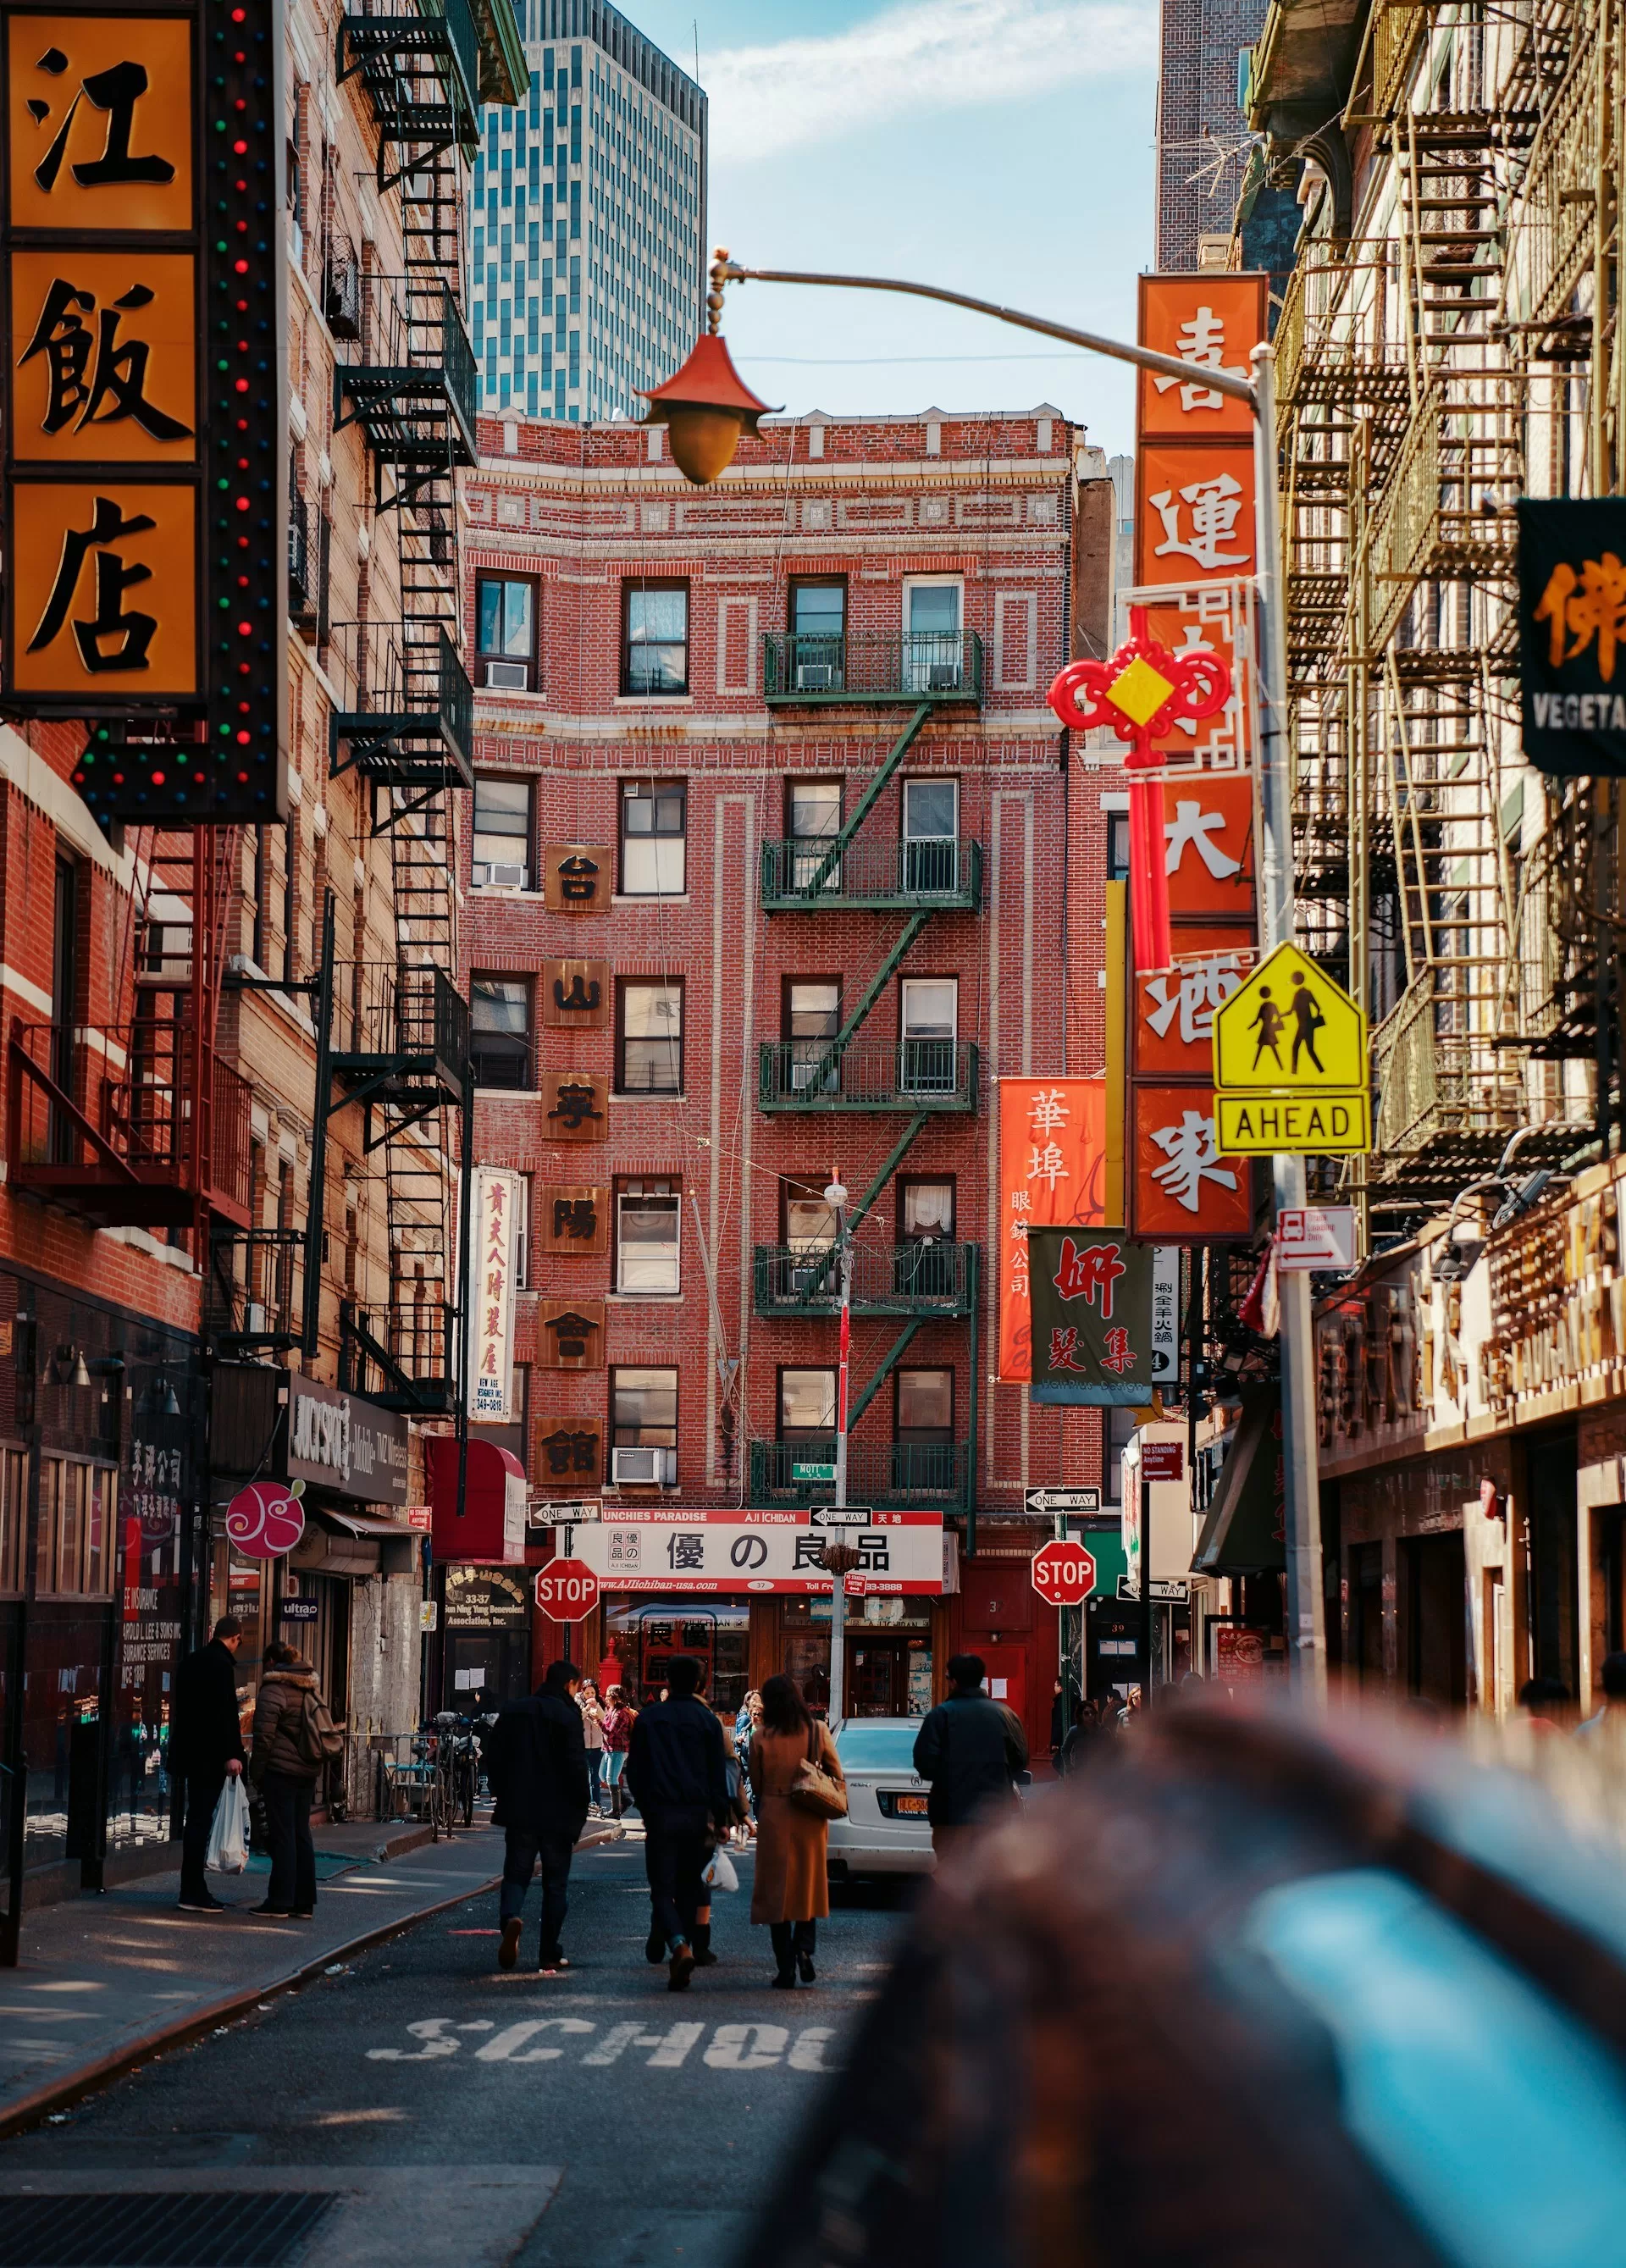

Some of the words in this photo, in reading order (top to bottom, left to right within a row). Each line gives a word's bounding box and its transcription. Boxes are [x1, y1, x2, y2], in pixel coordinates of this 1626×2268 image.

[17, 46, 196, 675] 江飯店
[1236, 1105, 1350, 1140] AHEAD
[1026, 1088, 1070, 1192] 華埠
[1009, 1190, 1033, 1297] 眼鏡公司
[479, 1378, 488, 1387] NEW
[1041, 1378, 1093, 1391] HairPlus
[1100, 1380, 1144, 1392] Design
[1152, 1446, 1176, 1454] STANDING
[799, 1465, 819, 1474] MOTT
[1035, 1496, 1057, 1505] ONE
[1070, 1495, 1092, 1505] WAY
[542, 1509, 562, 1519] ONE
[572, 1507, 594, 1518] WAY
[604, 1512, 650, 1522] UNCHIES
[654, 1512, 707, 1522] PARADISE
[744, 1513, 760, 1523] AJI
[761, 1513, 796, 1523] ICHIBAN
[820, 1513, 837, 1521] ONE
[666, 1531, 889, 1571] 優の良品
[1036, 1561, 1092, 1585] STOP
[540, 1578, 595, 1601] STOP
[600, 1579, 717, 1590] ww.AJIichiban-usa.com
[805, 1582, 819, 1590] Toll
[821, 1582, 834, 1590] Fre
[1161, 1586, 1181, 1596] WAY
[131, 1587, 158, 1610] INSURANCE
[465, 1594, 489, 1604] 33-37
[456, 1604, 472, 1616] Ning
[473, 1604, 489, 1616] Yung
[489, 1604, 524, 1613] Benevolent
[447, 1617, 491, 1626] Association,
[493, 1617, 506, 1625] Inc.
[146, 1623, 154, 1640] LEE
[160, 1622, 173, 1639] SONS
[1111, 1624, 1125, 1633] 39
[123, 1643, 147, 1662] SURANCE
[147, 1643, 170, 1661] SERVICES
